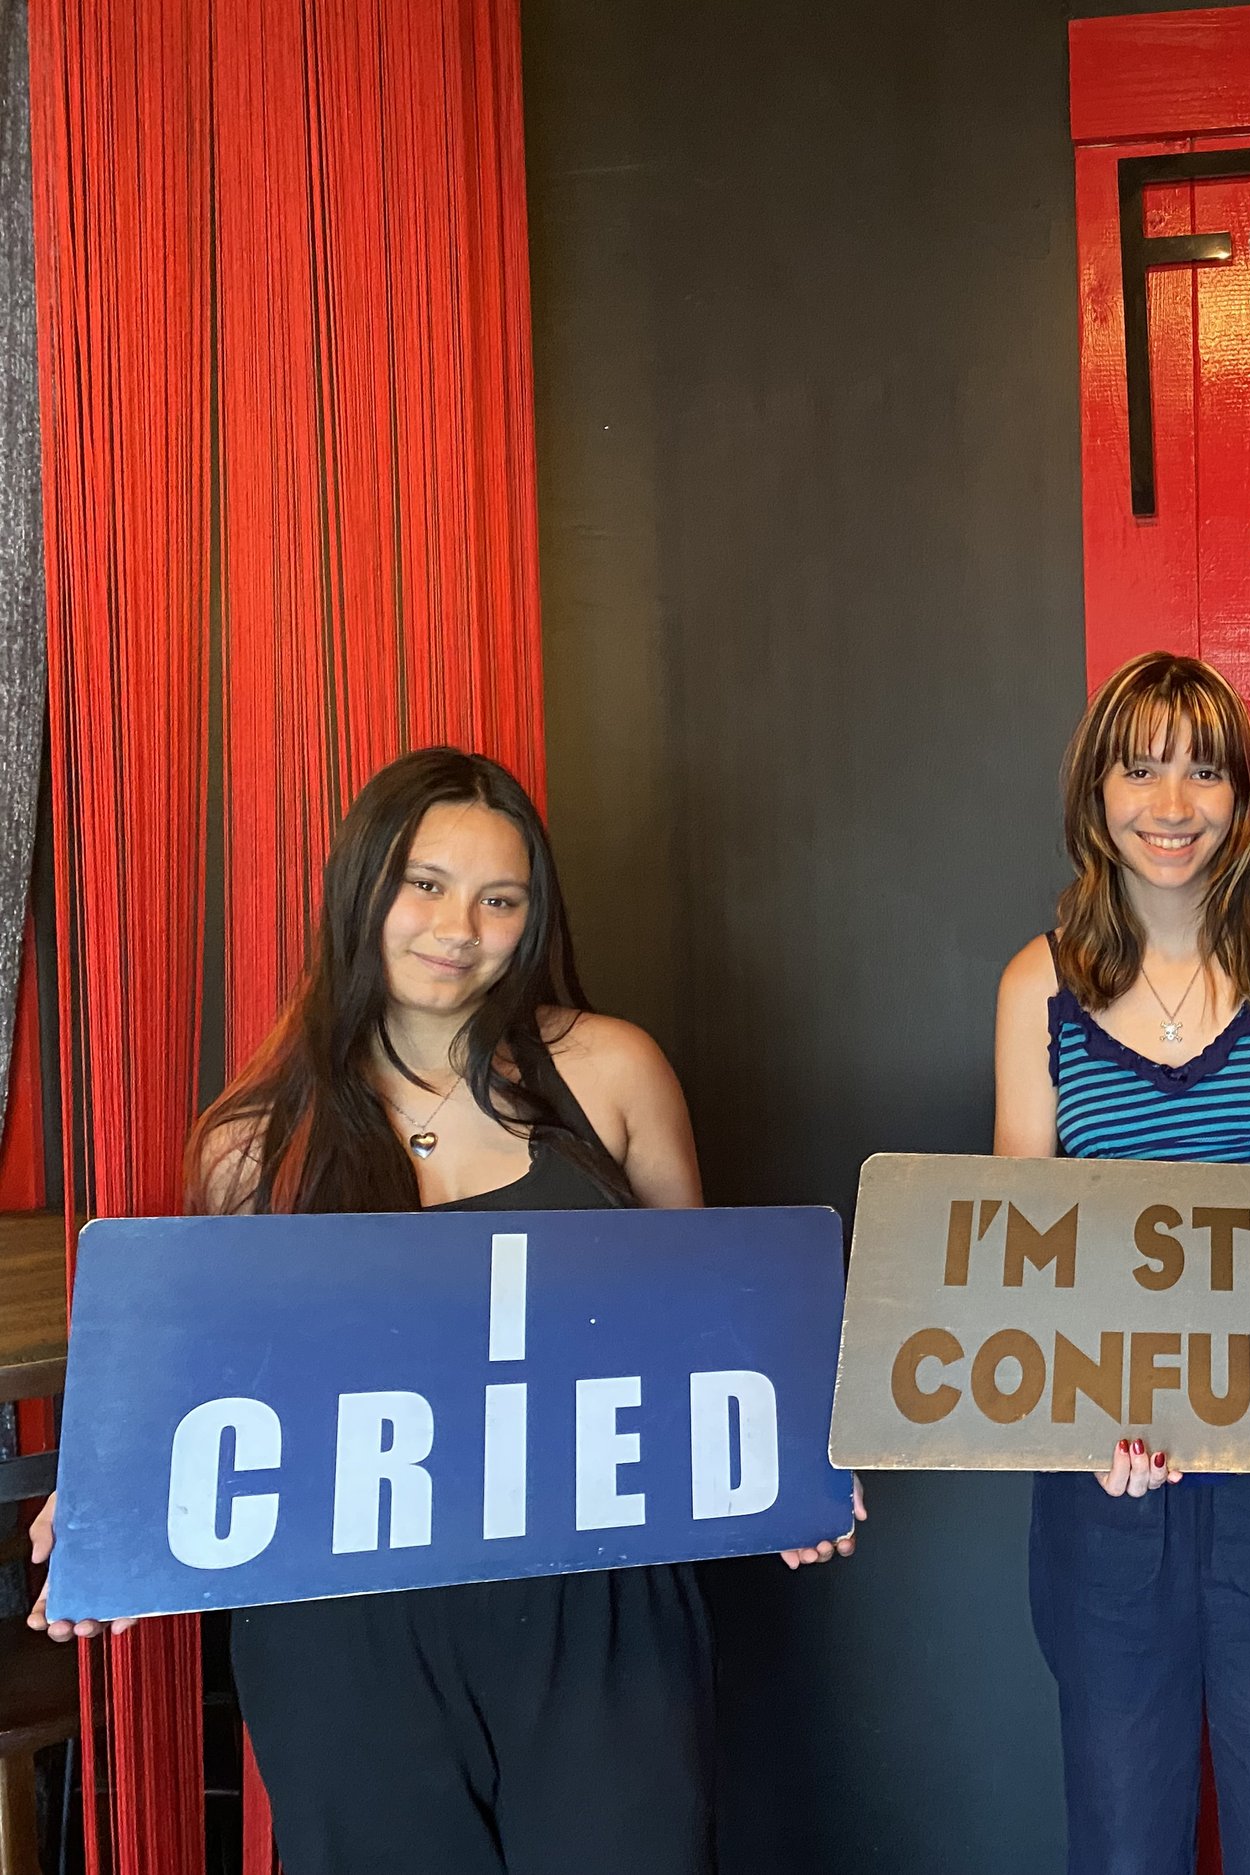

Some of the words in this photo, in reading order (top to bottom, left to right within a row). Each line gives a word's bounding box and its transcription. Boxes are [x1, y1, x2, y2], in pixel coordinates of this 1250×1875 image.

[488, 1233, 528, 1362] I
[943, 1200, 1080, 1288] I'M
[167, 1370, 780, 1570] CRIED
